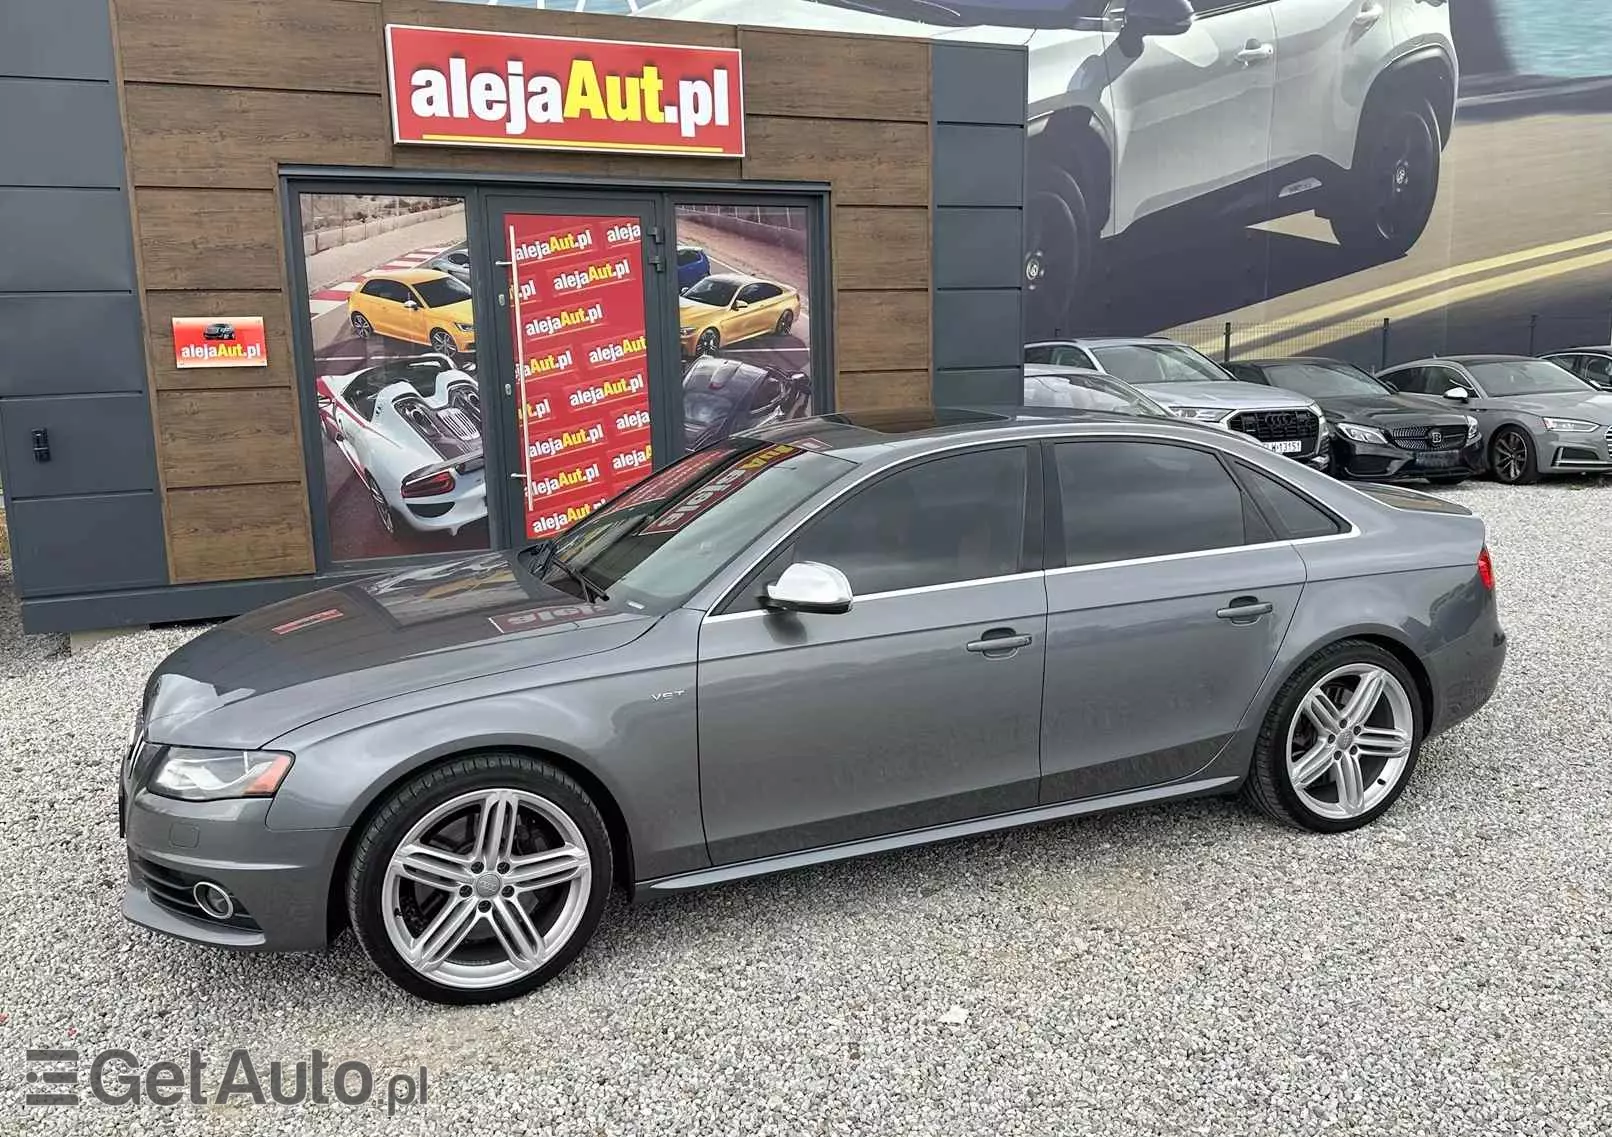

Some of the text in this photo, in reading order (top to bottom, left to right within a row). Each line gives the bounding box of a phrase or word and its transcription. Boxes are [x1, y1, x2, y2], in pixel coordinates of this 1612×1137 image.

[410, 57, 729, 137] alejaAut.pl
[515, 229, 592, 260] alejaAut.pl
[606, 222, 641, 244] aleja
[553, 259, 630, 290] alejaAut.pl
[525, 304, 603, 335] alejaAut.pl
[181, 343, 261, 360] alejaAut.pl
[589, 336, 647, 362] alejaAut
[569, 374, 643, 406] alejaAut.pl
[615, 410, 651, 430] aleja
[528, 424, 604, 457] alejaAut.pl
